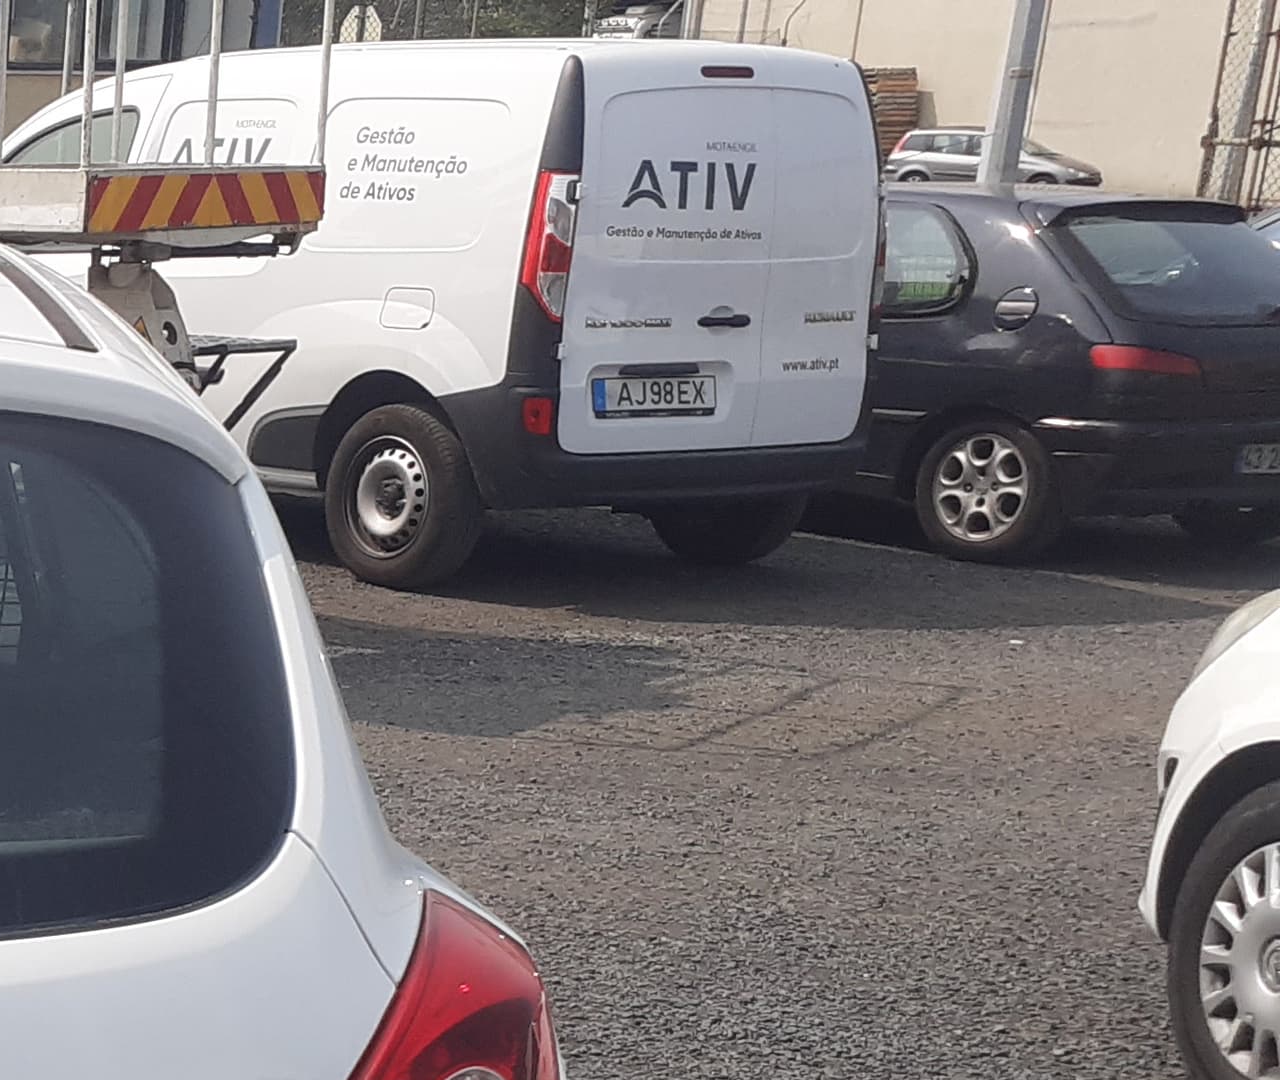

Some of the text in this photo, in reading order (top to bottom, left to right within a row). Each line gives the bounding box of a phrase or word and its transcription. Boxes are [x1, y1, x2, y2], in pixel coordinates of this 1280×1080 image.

[356, 126, 416, 145] Gestão
[347, 154, 468, 181] e Manutenção
[339, 182, 416, 201] de Ativos
[621, 159, 758, 212] ATIV
[606, 225, 762, 242] Gestão e Manutenção de Ativos
[782, 357, 839, 373] www.ativ.pt
[617, 379, 706, 407] AJ98EX
